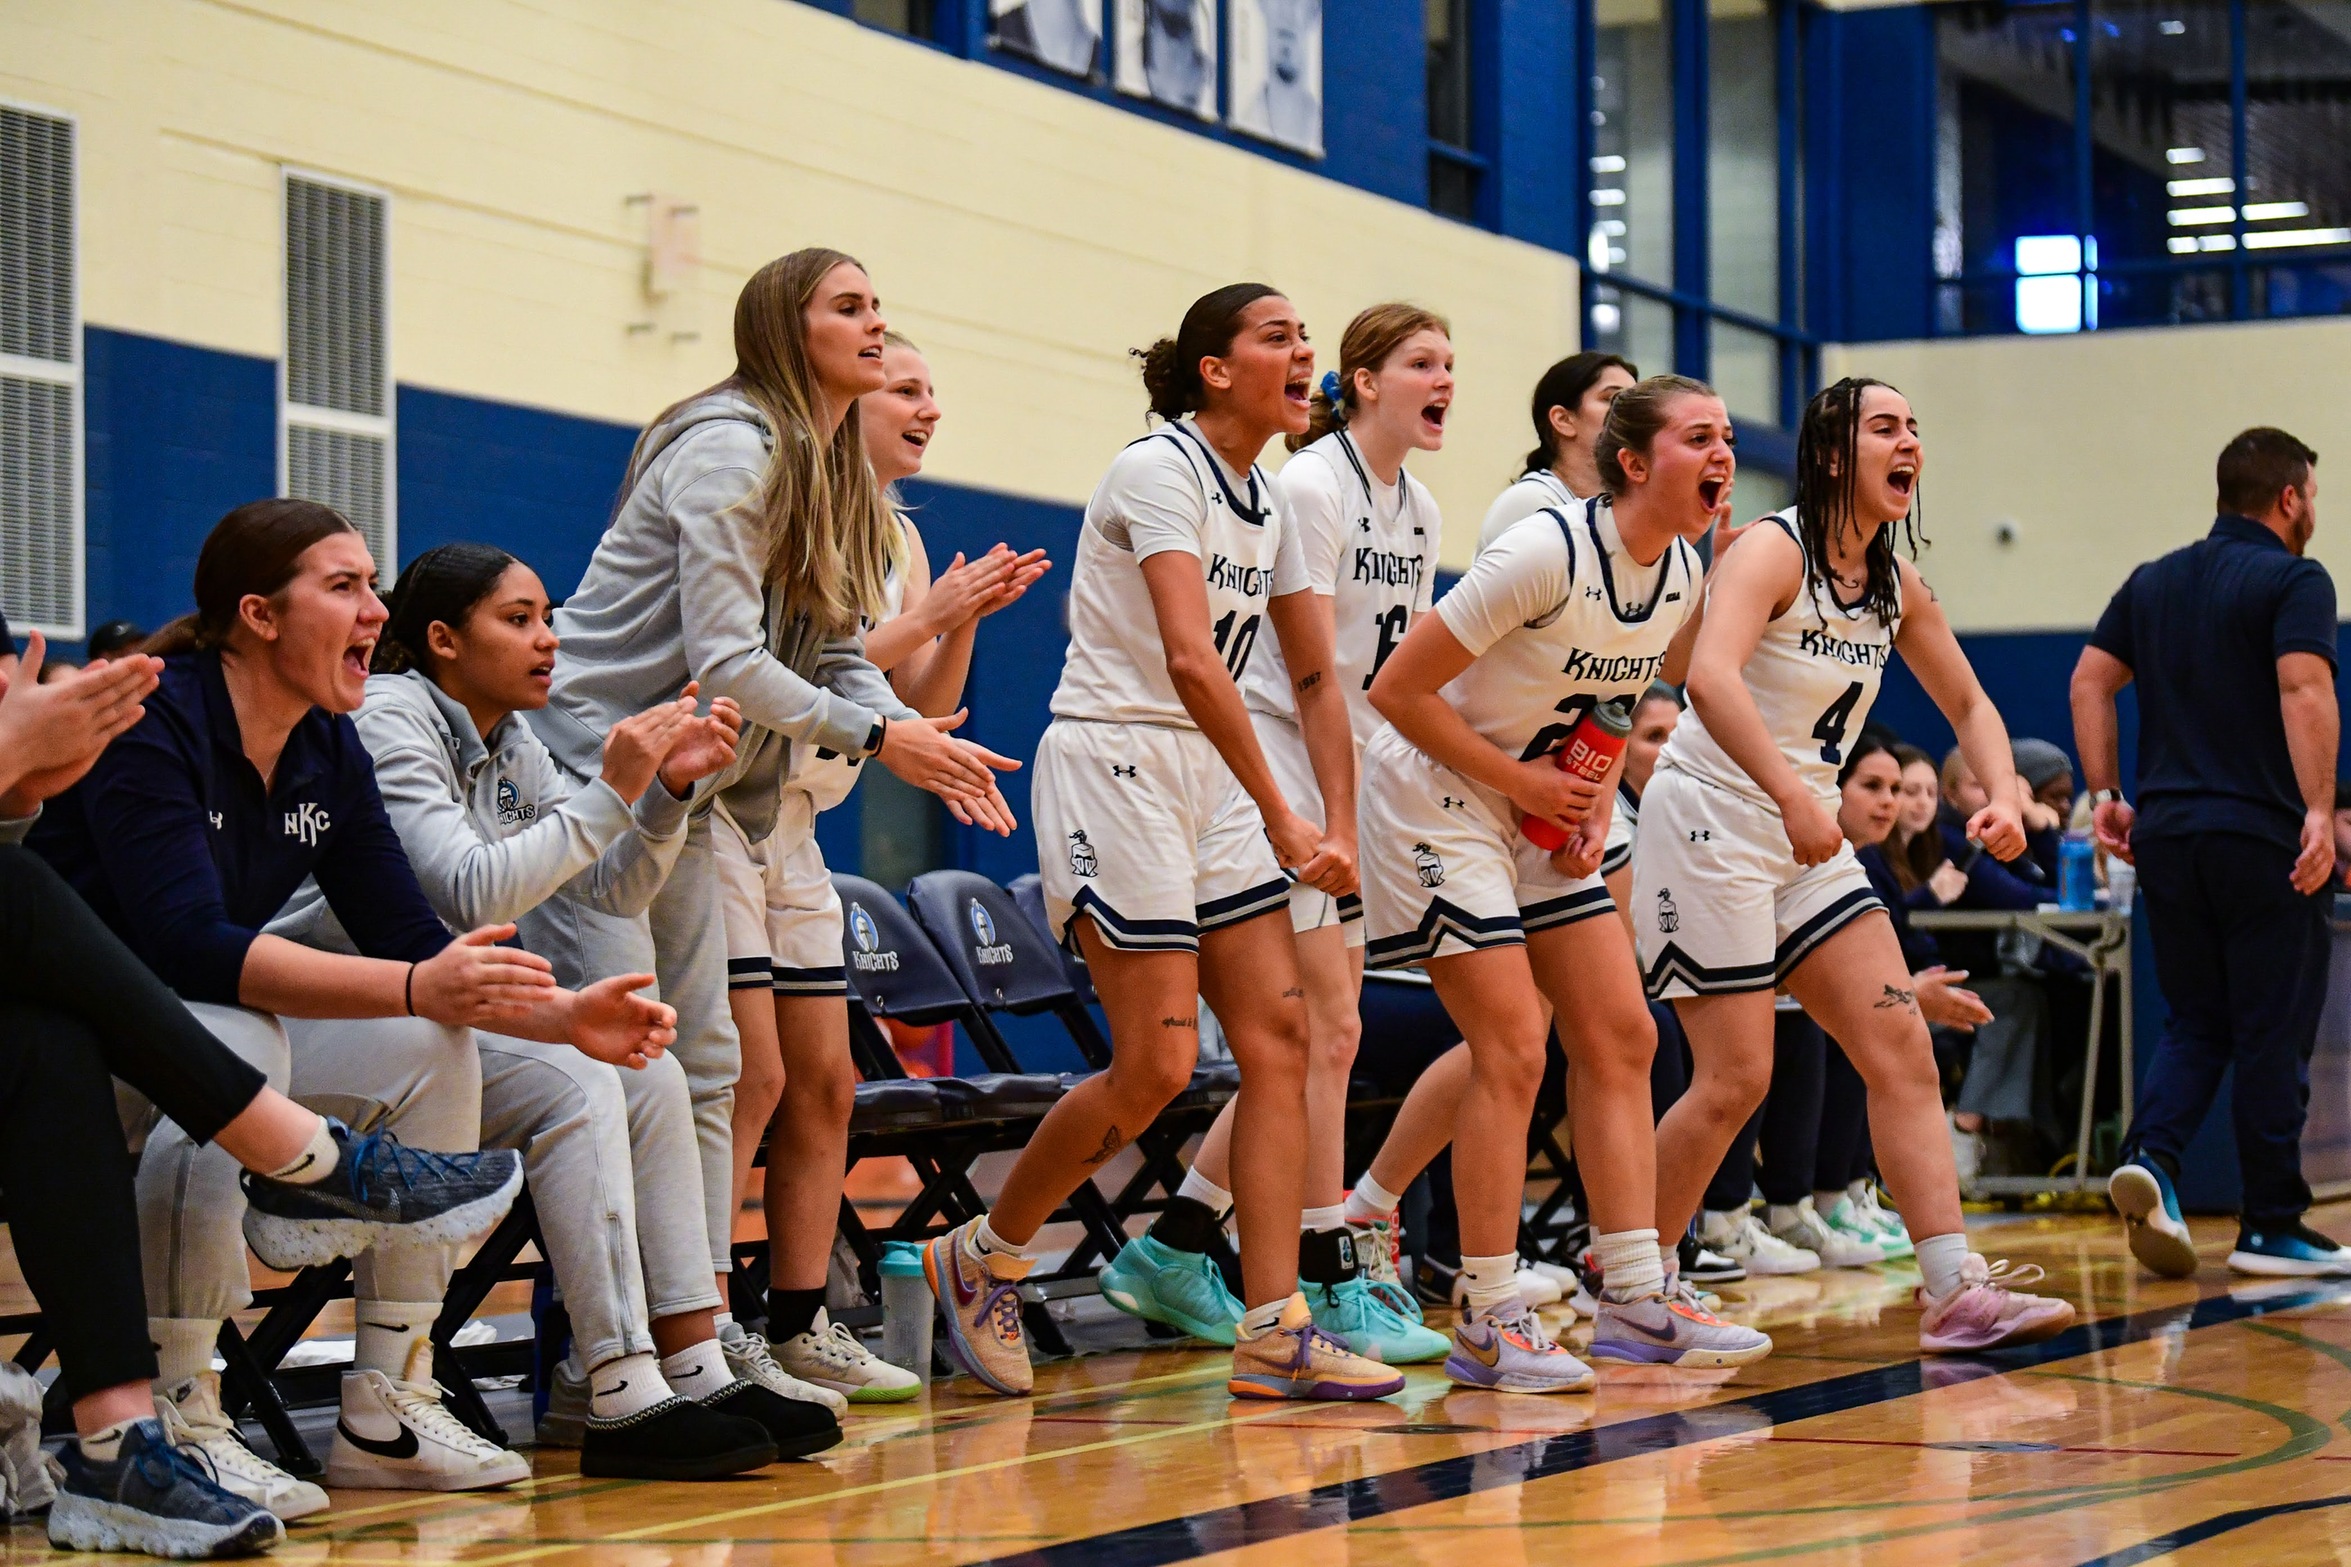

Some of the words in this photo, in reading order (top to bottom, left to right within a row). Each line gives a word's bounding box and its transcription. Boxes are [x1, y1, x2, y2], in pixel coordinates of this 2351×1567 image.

[1213, 609, 1261, 683] 10
[1561, 646, 1667, 683] KNIGHTS
[1799, 629, 1888, 670] KNIGHTS
[1811, 681, 1864, 766] 4
[1565, 755, 1601, 781] STEEL
[1570, 738, 1613, 773] BIO
[284, 802, 331, 848] NKC
[852, 950, 900, 972] KNIGHTS
[975, 943, 1014, 965] KNIGHTS
